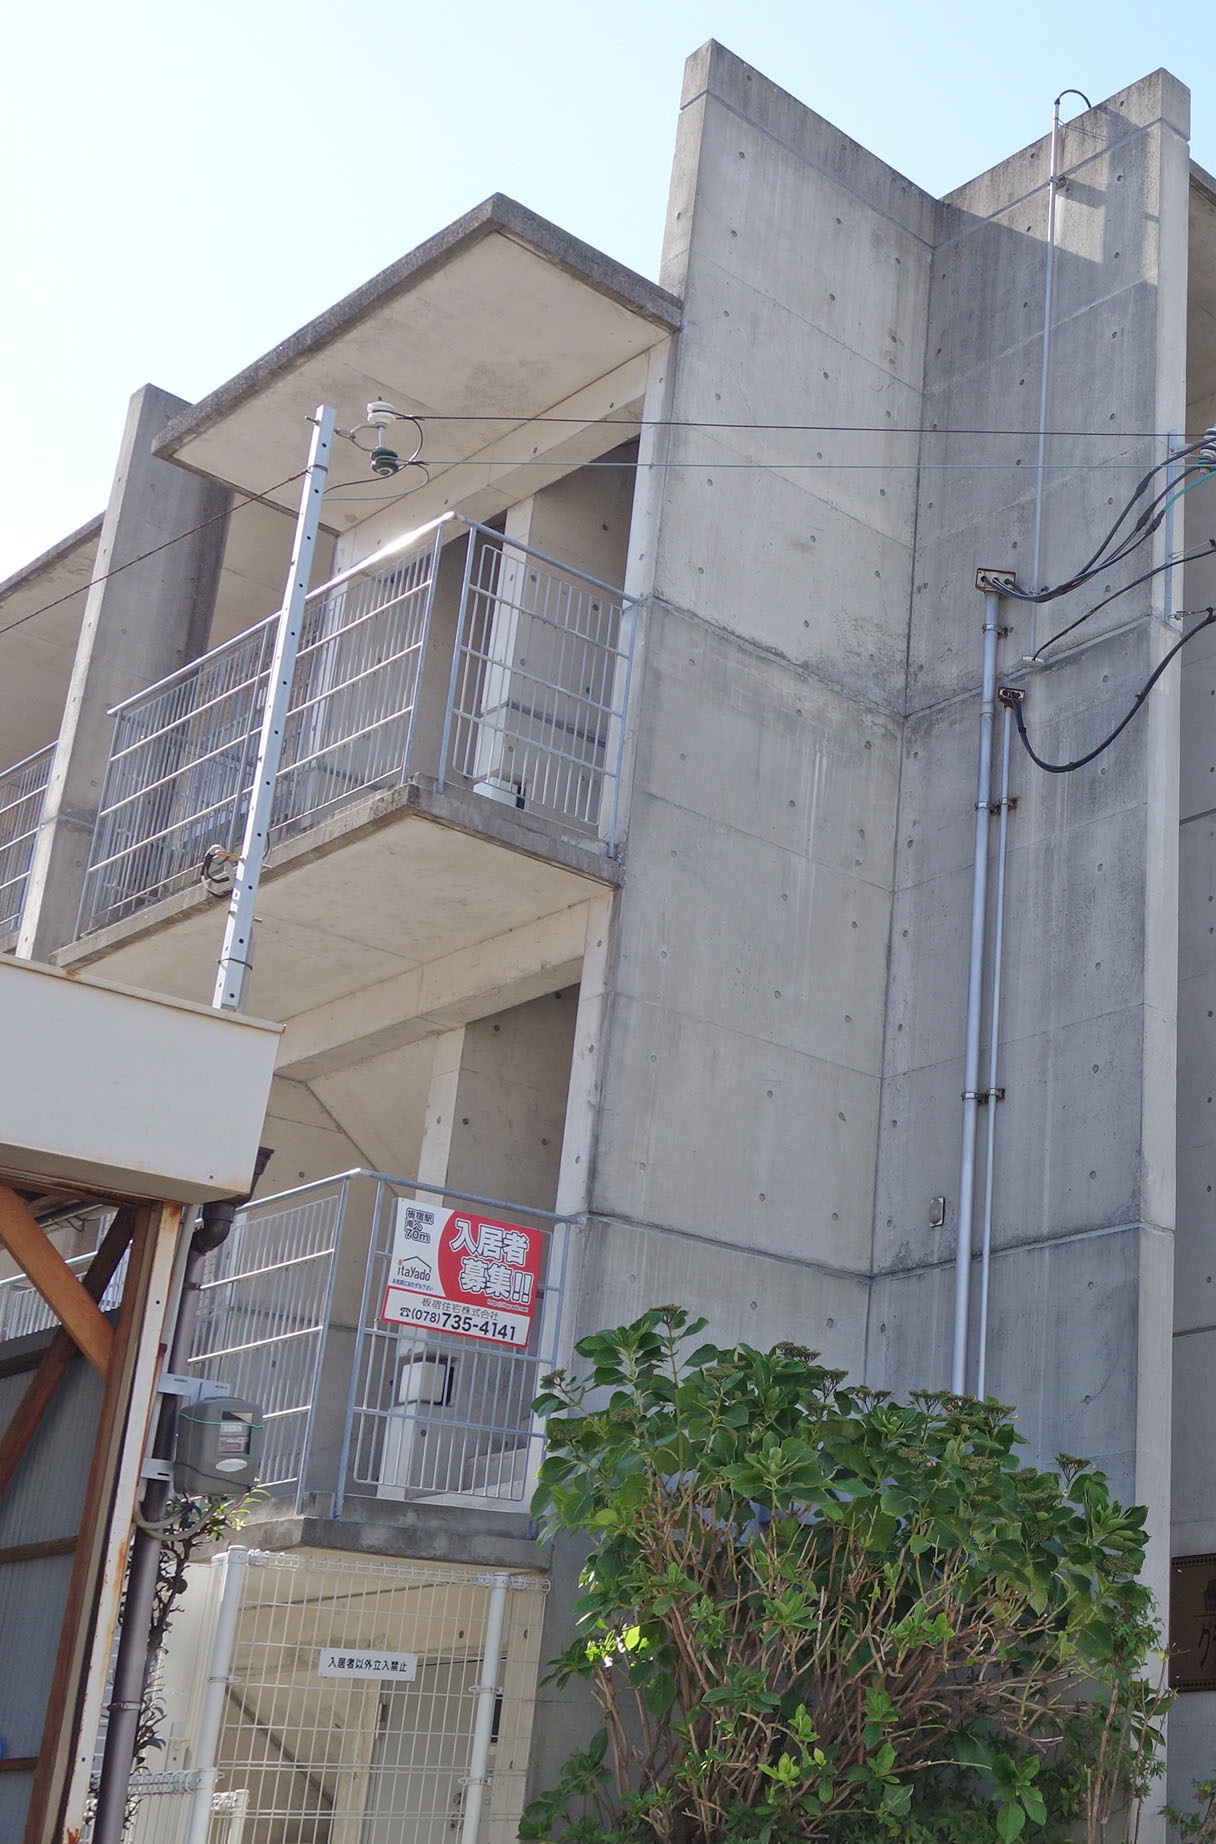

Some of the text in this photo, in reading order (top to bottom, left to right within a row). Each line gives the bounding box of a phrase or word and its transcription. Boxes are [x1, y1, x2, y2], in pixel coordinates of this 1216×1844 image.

[405, 1228, 430, 1243] 70m
[449, 1218, 529, 1267] 入居者
[422, 1297, 499, 1320] 板宿住宅株式会社
[328, 1656, 407, 1672] 入居者以外立入禁止
